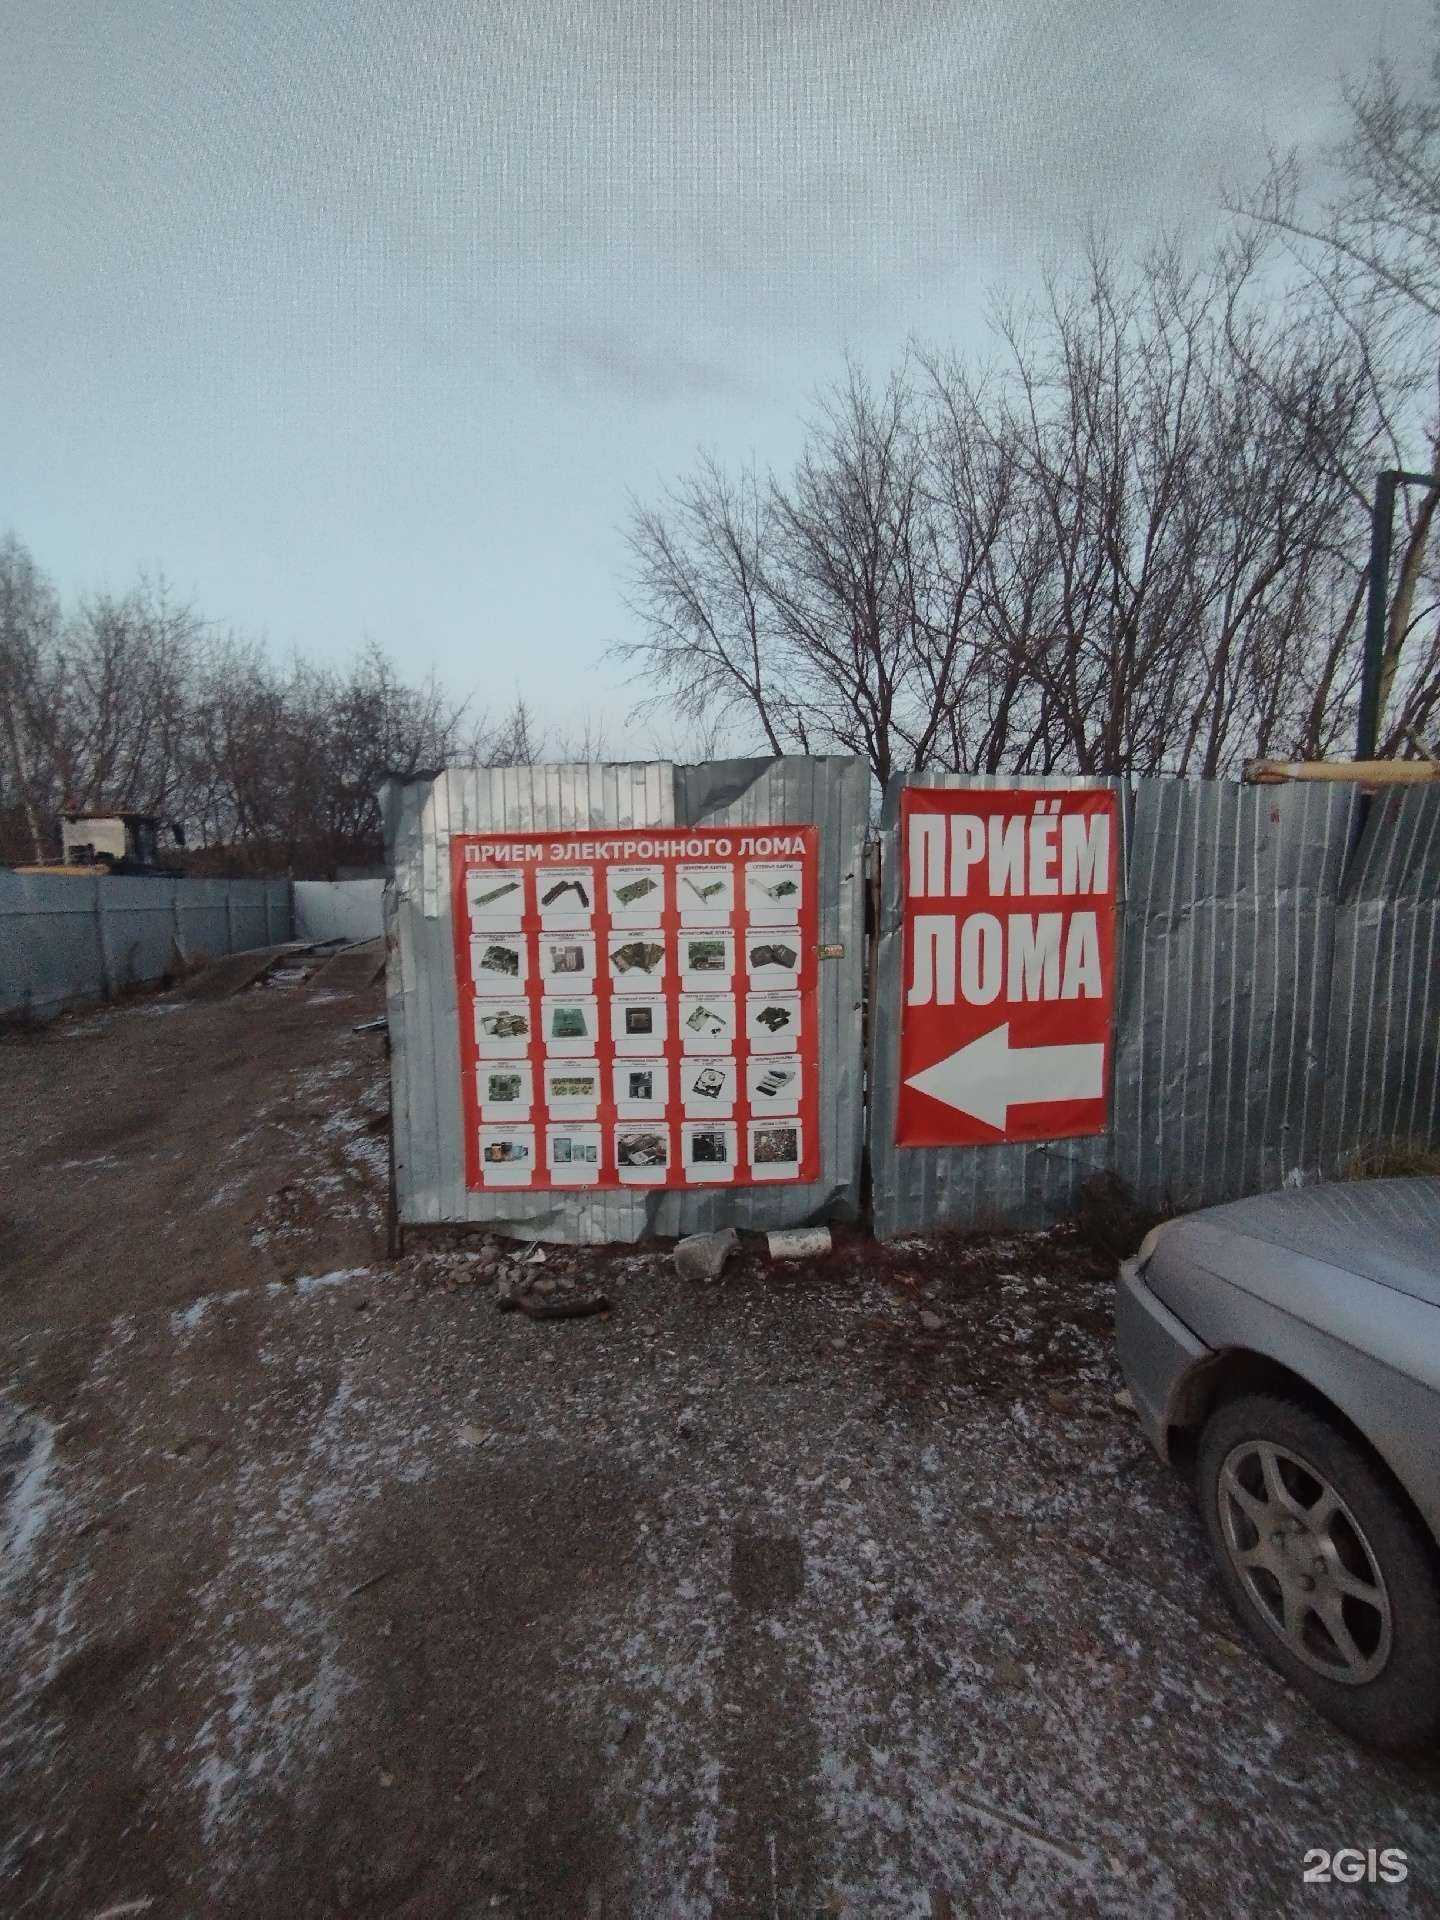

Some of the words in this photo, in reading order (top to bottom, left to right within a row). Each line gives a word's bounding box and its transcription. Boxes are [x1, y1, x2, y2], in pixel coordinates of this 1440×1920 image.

[464, 843, 543, 862] ПРИЕМ
[550, 838, 732, 860] ЭЛЕКТРОННОГО
[738, 837, 807, 856] ЛОМА
[908, 799, 1111, 897] ПРИЁМ
[907, 911, 1104, 1007] ЛОМА
